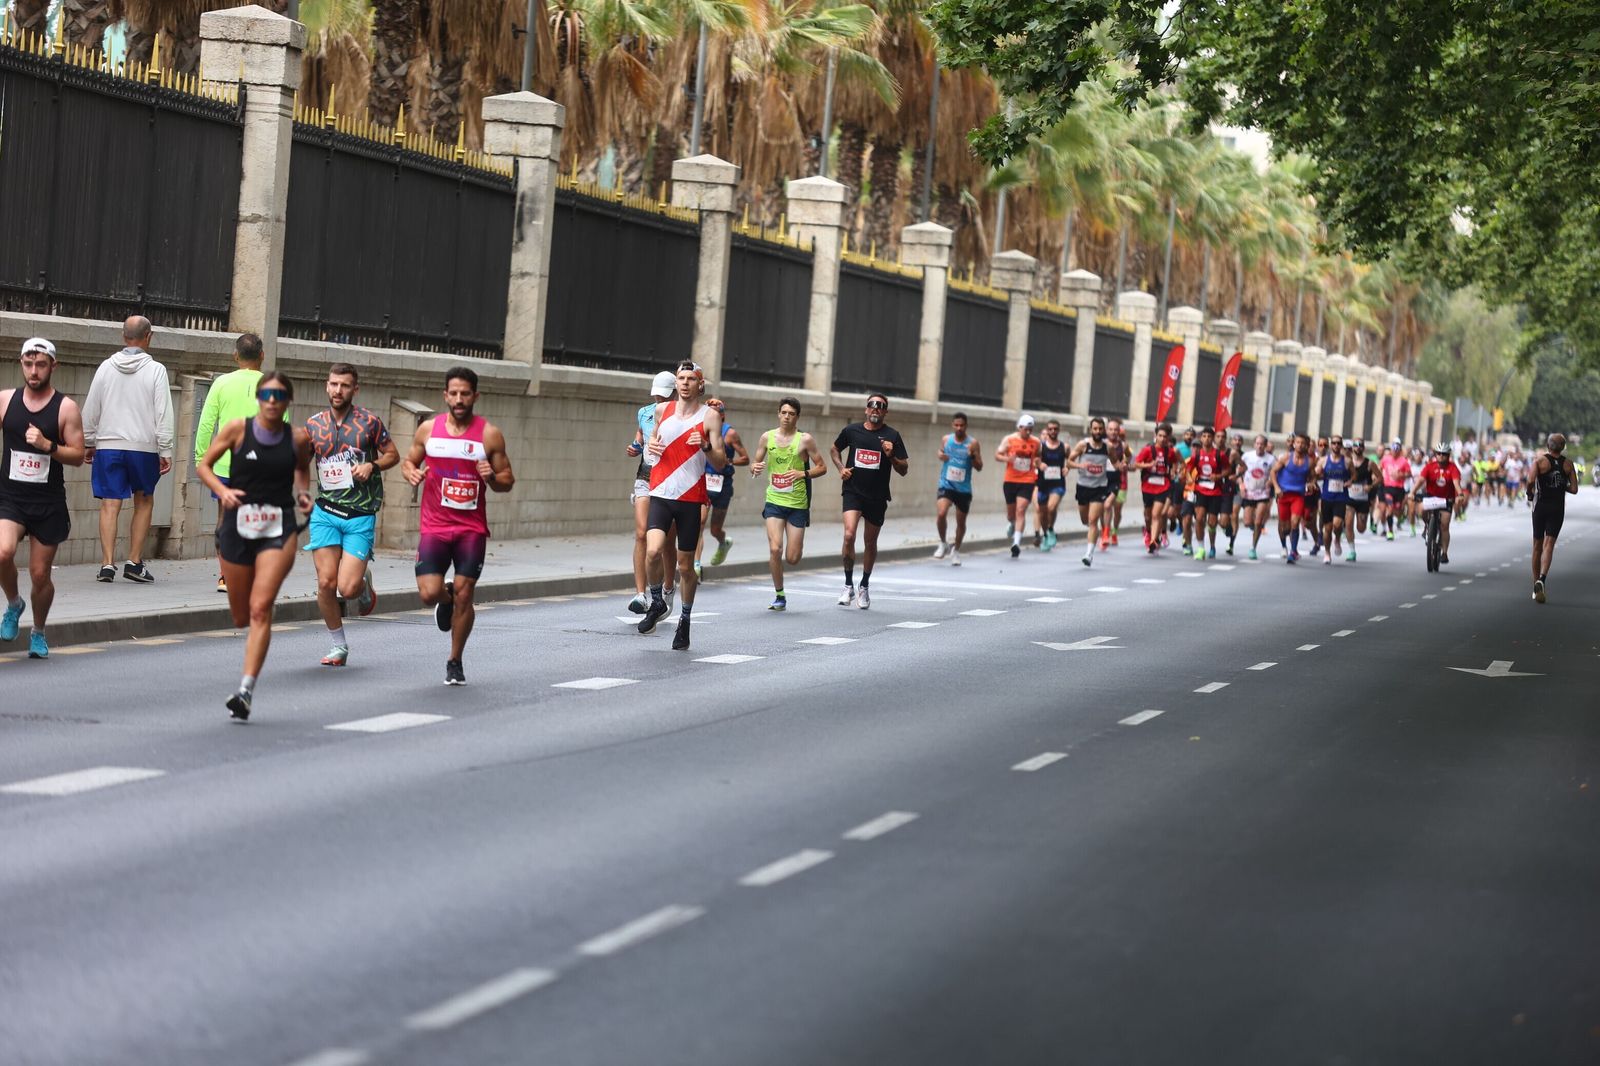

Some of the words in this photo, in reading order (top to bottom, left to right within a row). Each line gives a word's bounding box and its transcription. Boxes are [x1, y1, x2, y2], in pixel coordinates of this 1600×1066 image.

[20, 459, 41, 469] 738
[324, 469, 343, 478] 742
[447, 486, 474, 497] 2726
